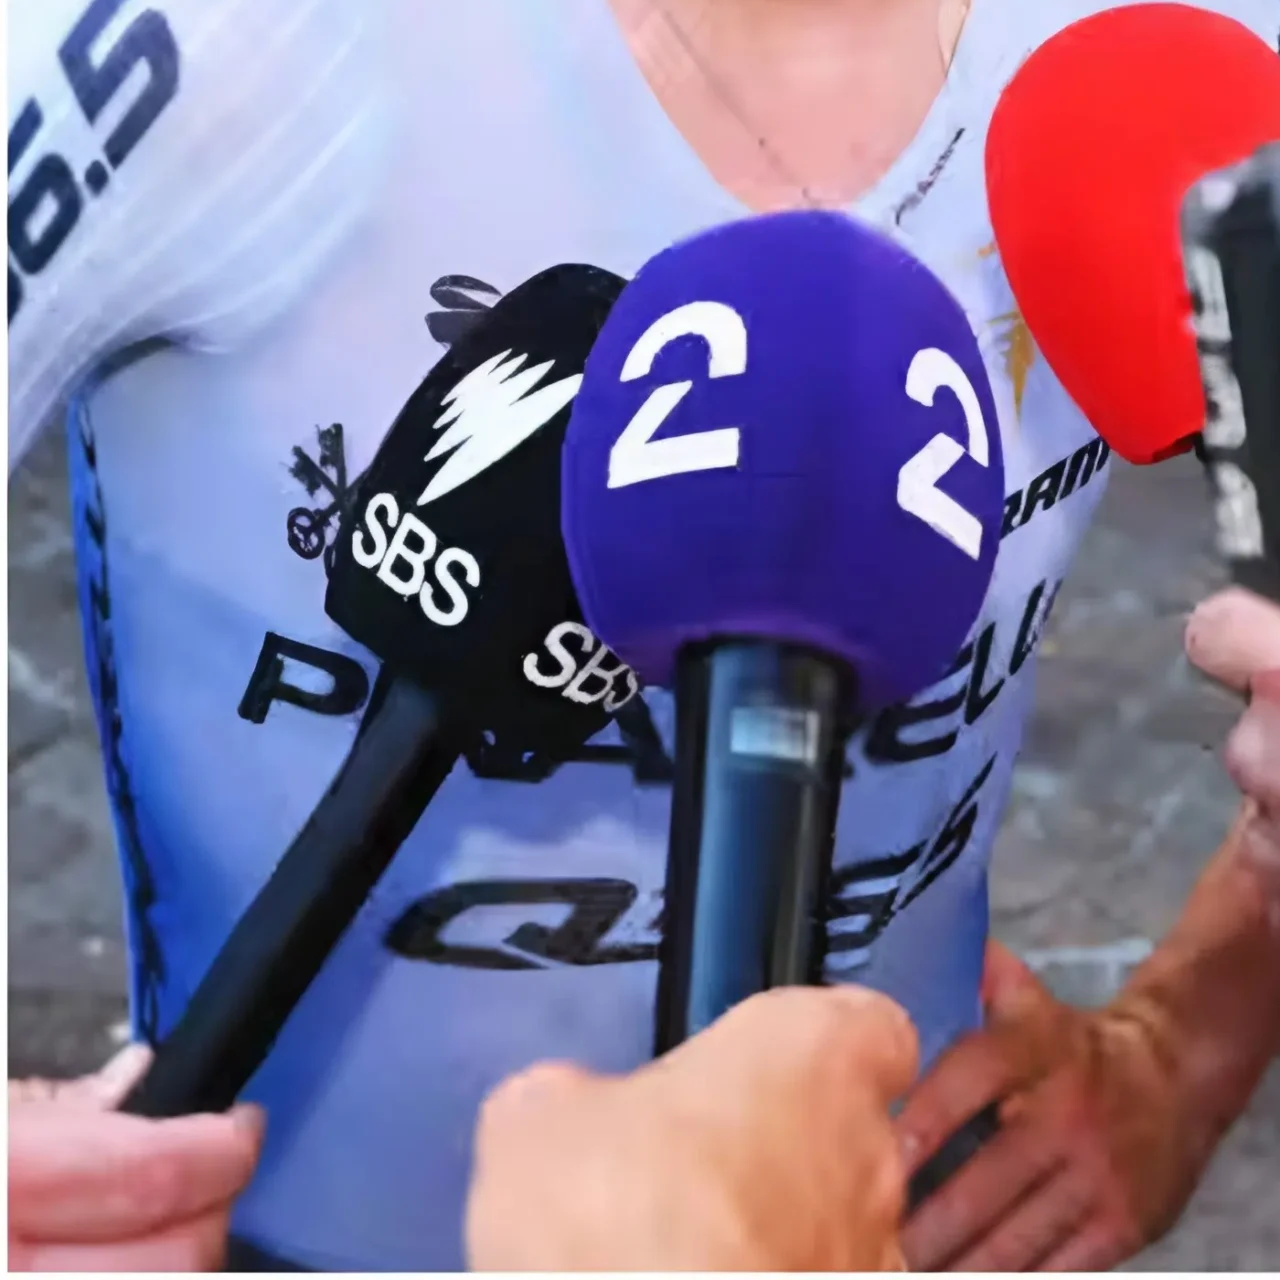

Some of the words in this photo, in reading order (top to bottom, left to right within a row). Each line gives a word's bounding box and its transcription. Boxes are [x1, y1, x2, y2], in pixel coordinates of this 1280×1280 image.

[606, 299, 748, 490] 2
[896, 347, 990, 560] 2
[351, 492, 481, 627] SBS
[522, 620, 642, 712] SBS
